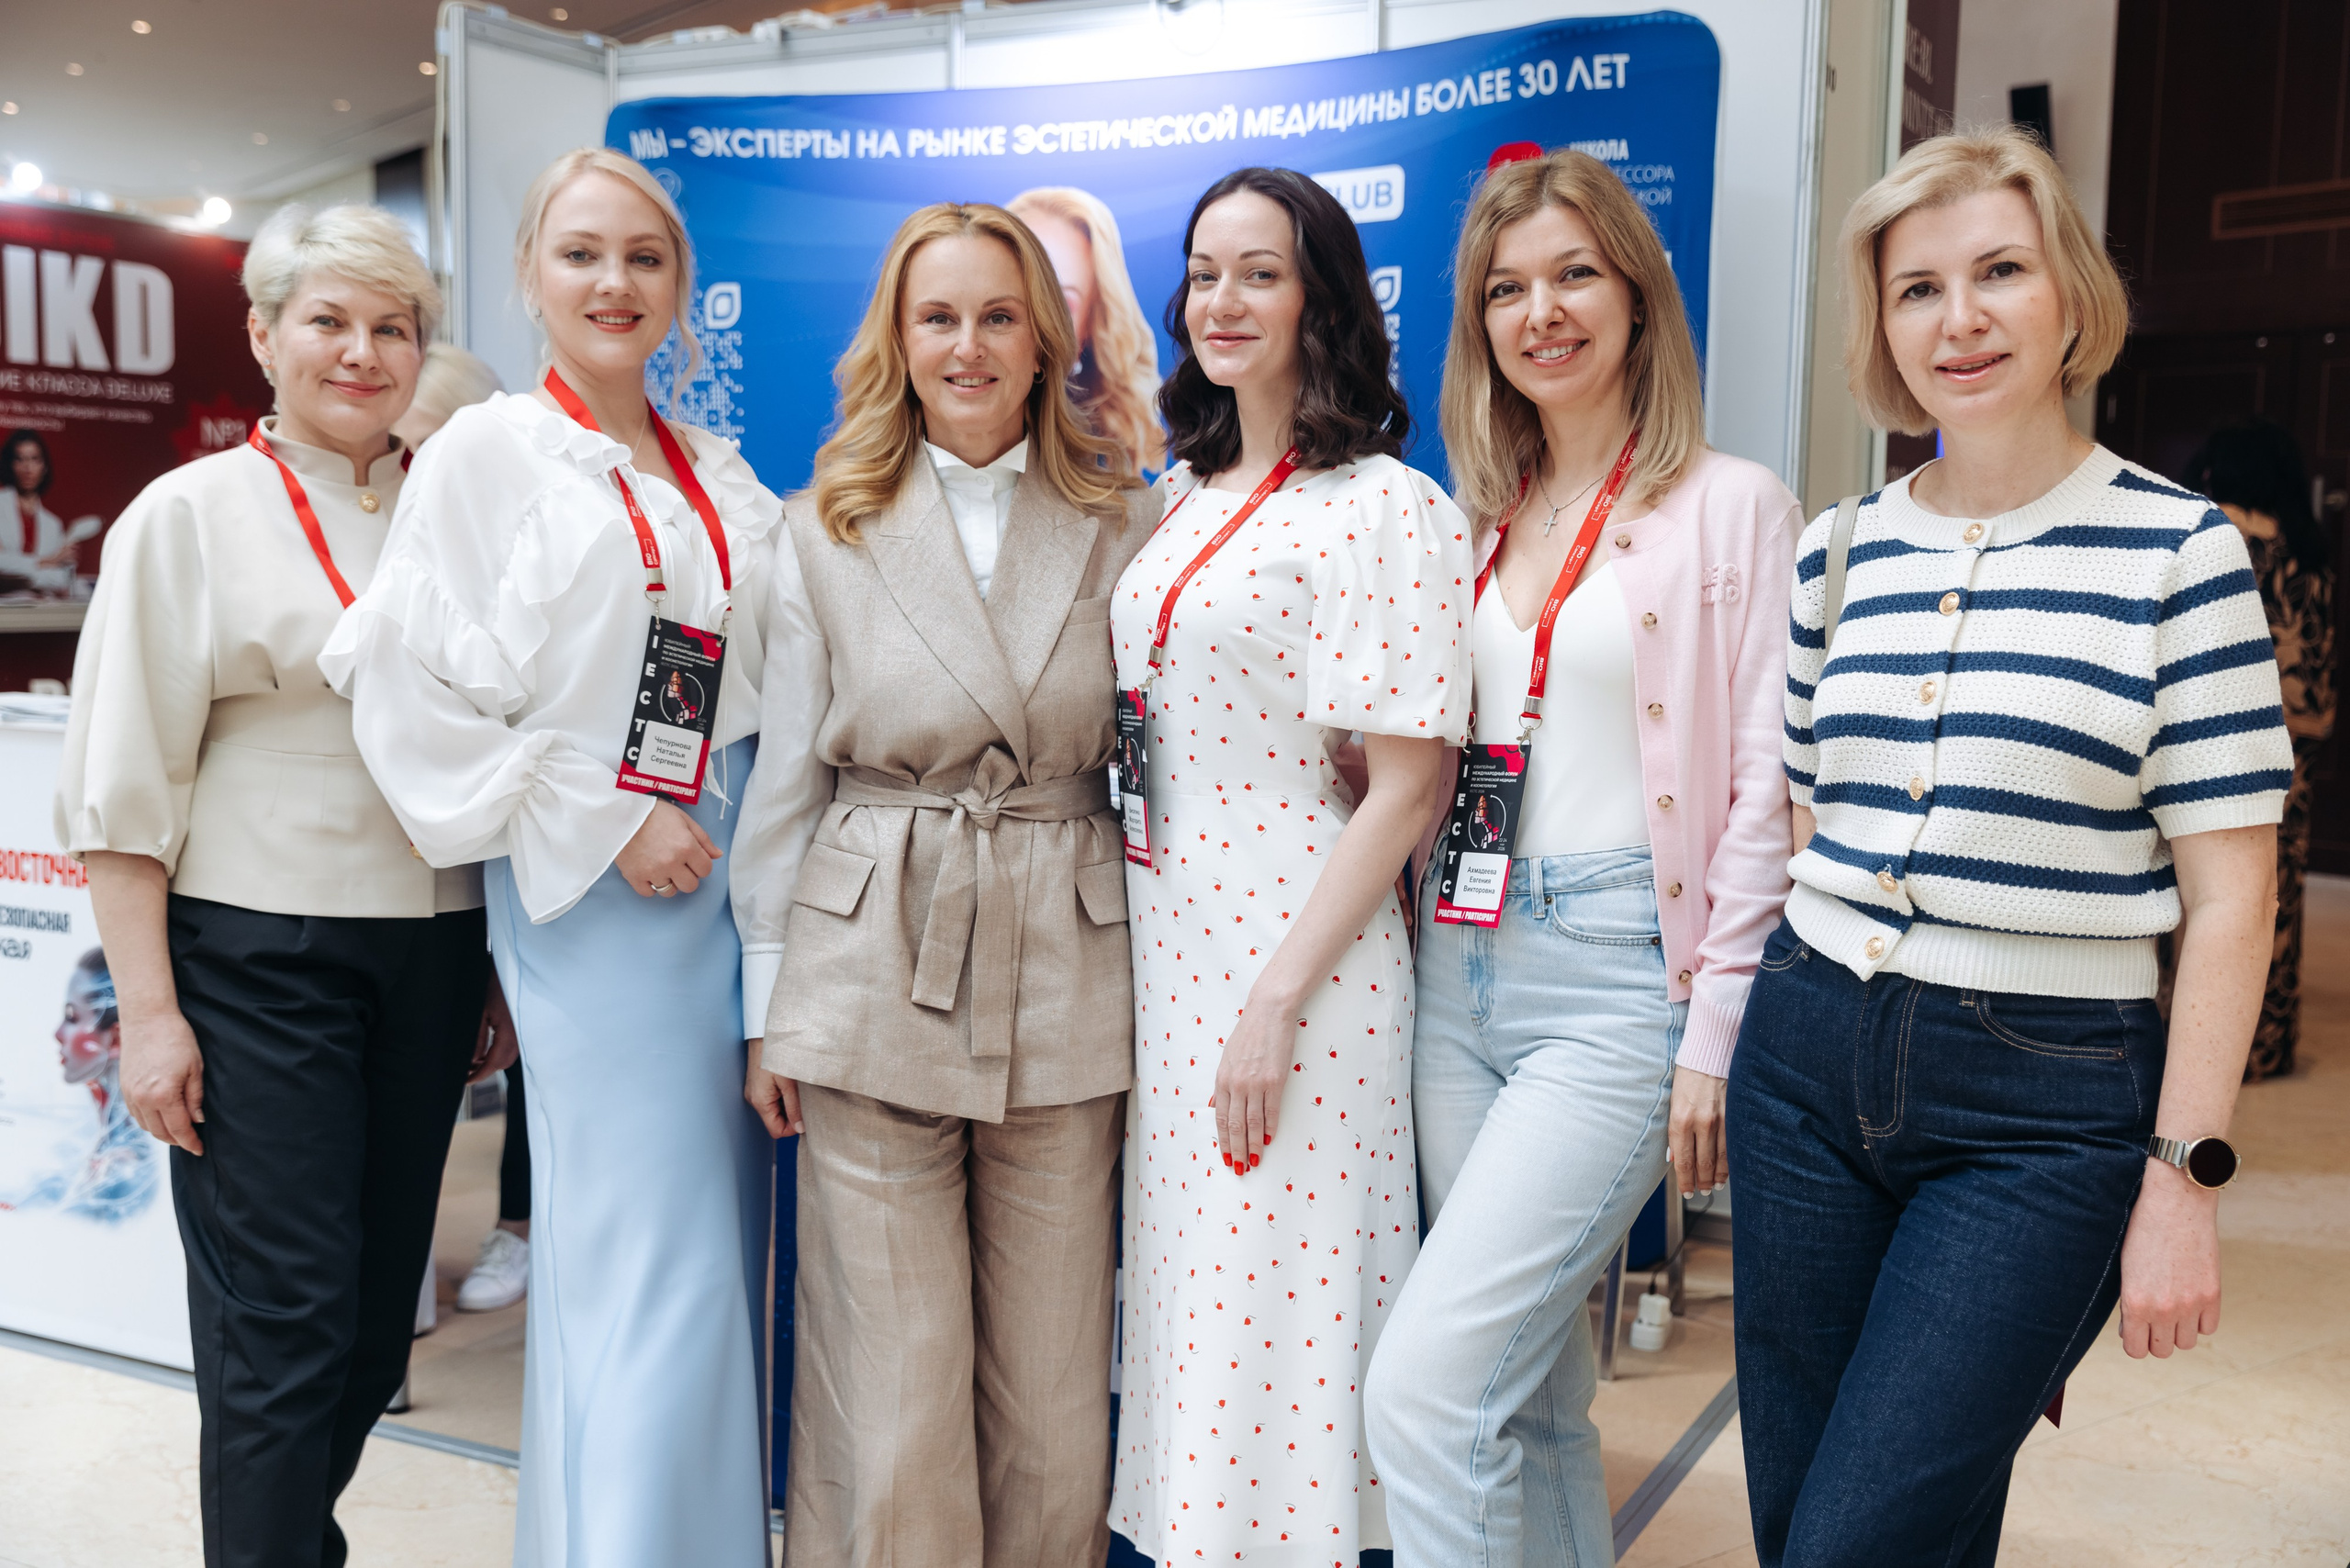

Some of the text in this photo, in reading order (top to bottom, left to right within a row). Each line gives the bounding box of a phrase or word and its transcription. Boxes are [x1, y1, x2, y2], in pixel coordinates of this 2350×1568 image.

[629, 128, 668, 161] МЫ
[688, 126, 850, 159] ЭКСПЕРТЫ
[856, 129, 901, 159] НА
[906, 125, 1007, 158] РЫНКЕ
[1012, 104, 1238, 155] ЭСТЕТИЧЕСКОЙ
[1242, 86, 1410, 140] МЕДИЦИНЫ
[1415, 67, 1512, 117] БОЛЕЕ
[1517, 59, 1559, 98] 30
[1565, 53, 1630, 92] ЛЕТ
[1285, 452, 1296, 464] BIO
[1248, 493, 1259, 504] BIO
[1603, 495, 1613, 508] BIO
[1212, 534, 1222, 545] BIO
[1576, 546, 1586, 559] BIO
[645, 553, 654, 566] BIO
[1174, 576, 1184, 588] BIO
[1550, 599, 1560, 612] BIO
[655, 735, 692, 751] Чепурнова
[656, 746, 686, 759] Наталья
[650, 755, 687, 769] Сергеевна
[621, 774, 655, 789] УЧАСТНИК
[657, 781, 697, 797] PARTICIPANT
[1467, 866, 1497, 875] Ахмадеева
[1469, 876, 1492, 884] Евгения
[1462, 885, 1495, 895] Викторовна
[1438, 908, 1462, 919] УЧАСТНИК
[1464, 911, 1496, 923] PARTICIPANT
